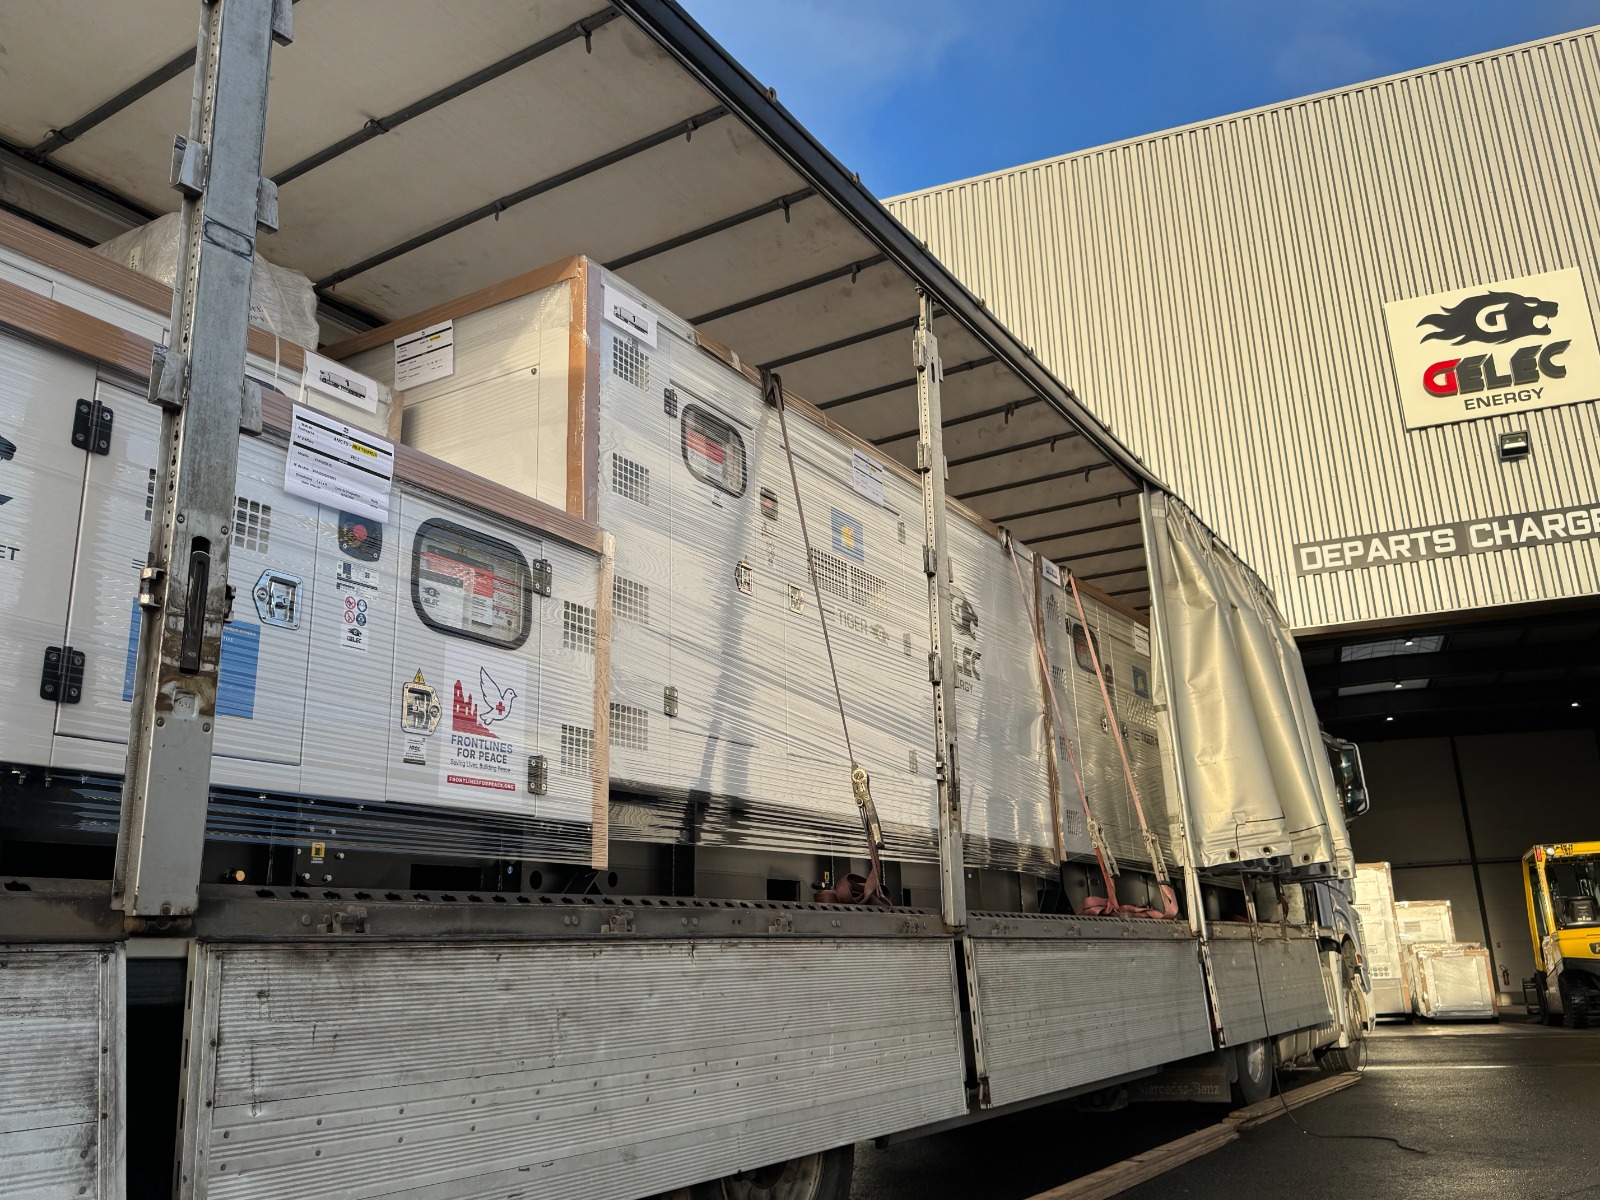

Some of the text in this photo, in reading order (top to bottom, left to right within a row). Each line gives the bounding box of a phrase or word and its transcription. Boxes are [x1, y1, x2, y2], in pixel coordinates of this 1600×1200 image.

[1423, 339, 1572, 398] GELEC
[1463, 387, 1544, 411] ENERGY
[1299, 528, 1457, 571] DEPARTS
[837, 607, 868, 635] TIGER
[451, 734, 513, 754] FRONTLINES
[457, 748, 508, 764] FOR PEACE
[479, 763, 497, 773] Building
[497, 765, 511, 773] Peace
[449, 776, 514, 790] FRONTLINESFORPEACE.ORG
